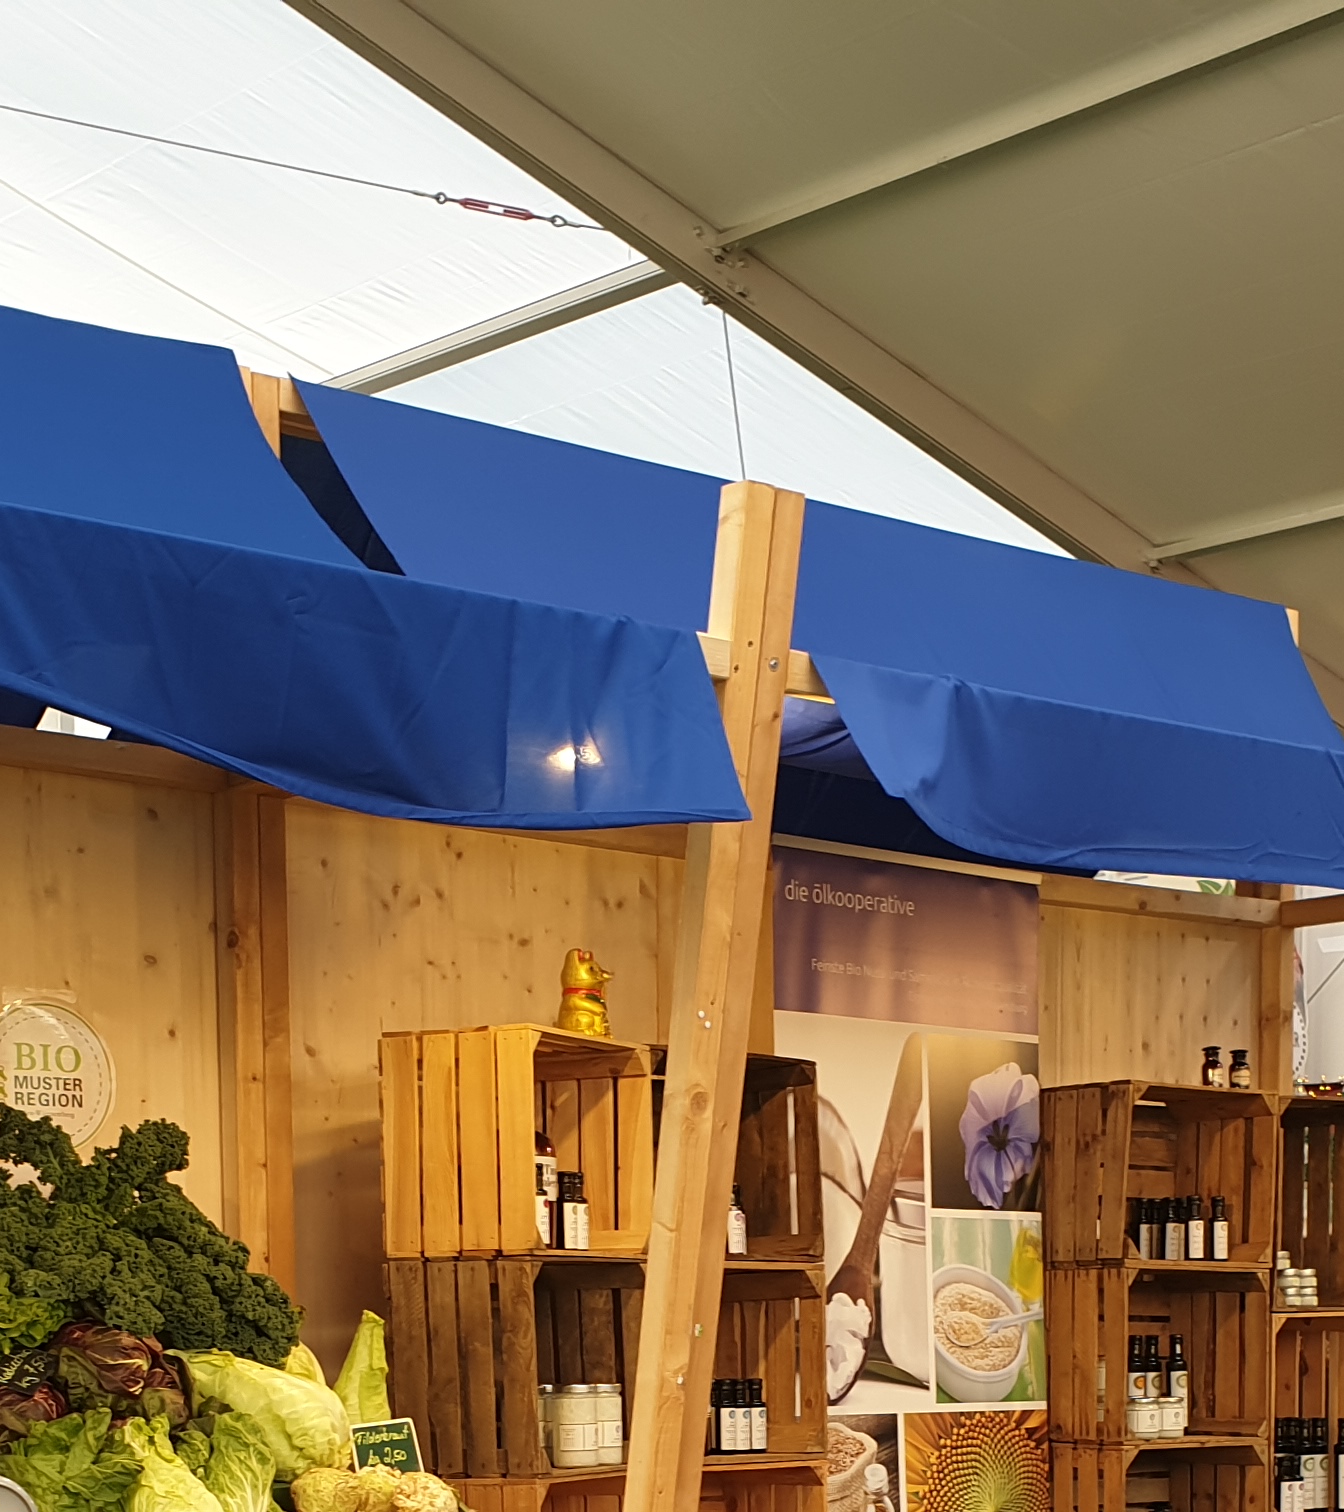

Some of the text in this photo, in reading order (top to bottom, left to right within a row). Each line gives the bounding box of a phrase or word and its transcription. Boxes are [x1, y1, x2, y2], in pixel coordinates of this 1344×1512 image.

[784, 879, 809, 902] die
[13, 1042, 82, 1073] BIO
[14, 1075, 83, 1092] MUSTER
[14, 1091, 84, 1108] REGION
